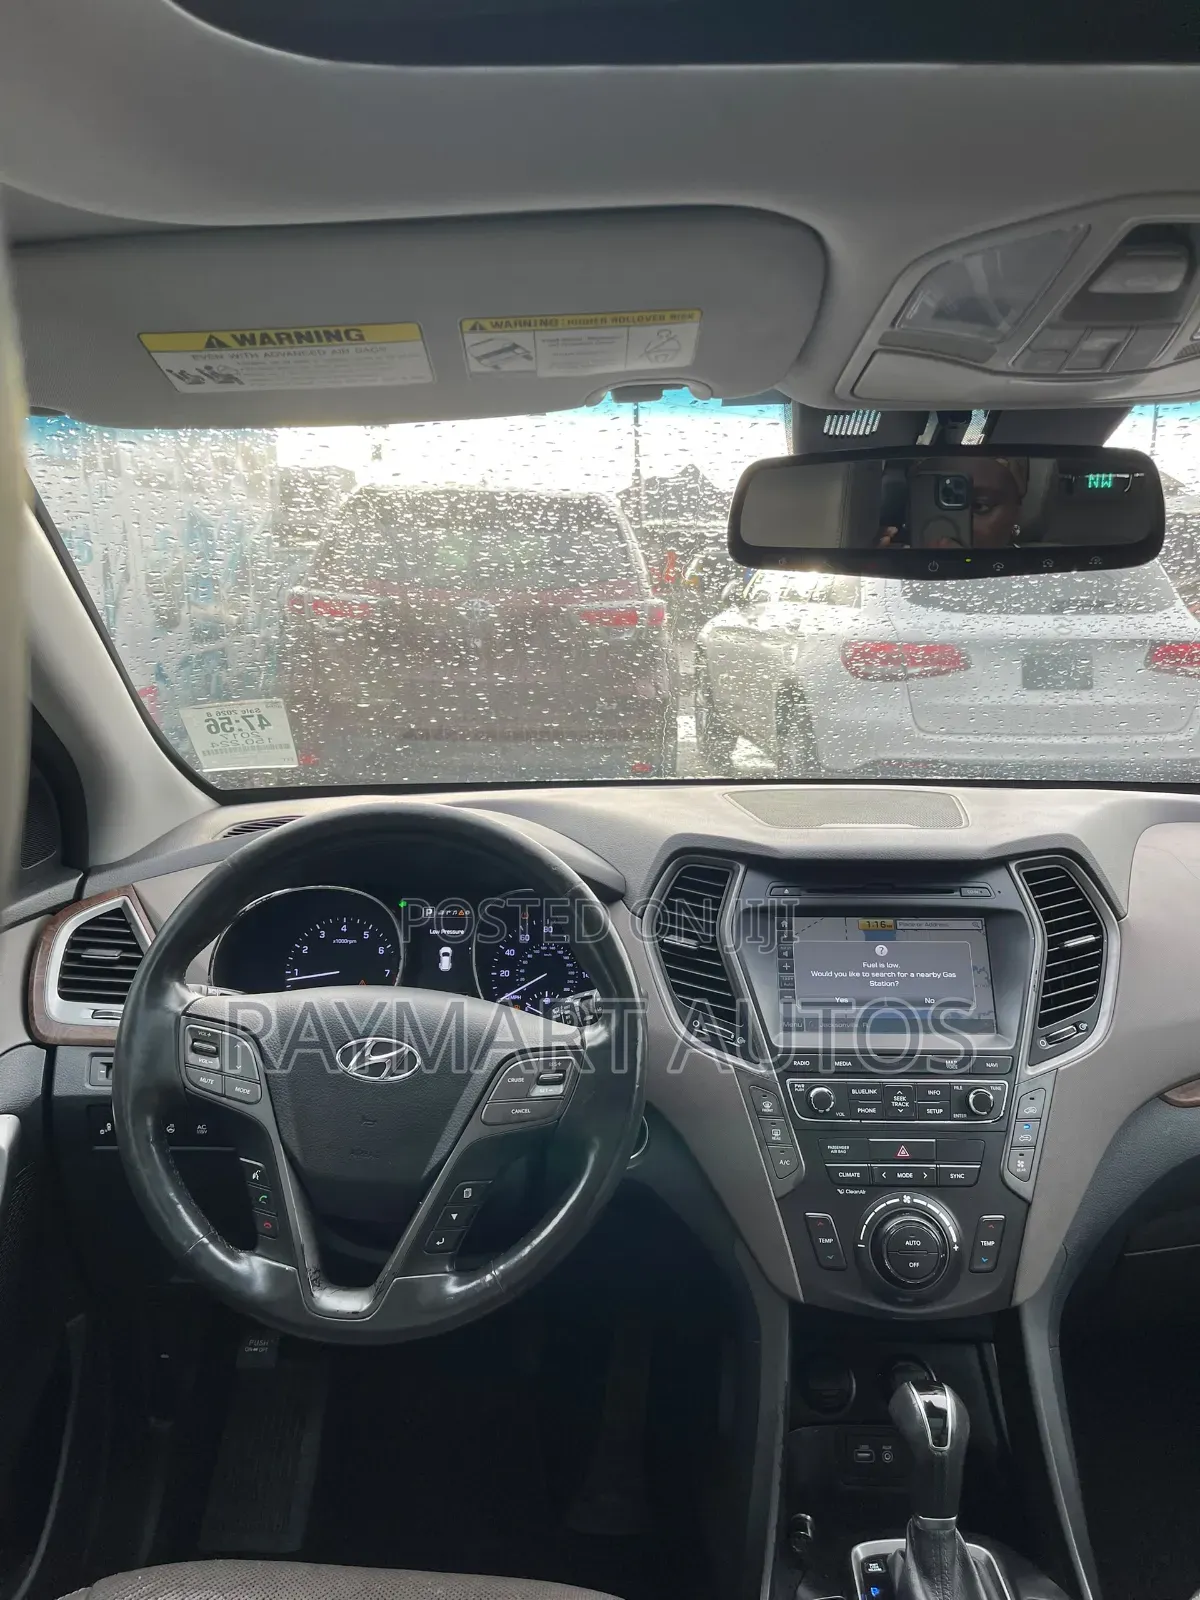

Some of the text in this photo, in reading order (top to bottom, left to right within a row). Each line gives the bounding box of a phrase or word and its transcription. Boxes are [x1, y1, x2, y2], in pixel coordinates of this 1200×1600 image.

[230, 328, 366, 347] WARNING
[1088, 473, 1112, 488] NW
[341, 924, 347, 932] 4
[319, 930, 326, 938] 3
[363, 931, 369, 939] 5
[520, 934, 530, 942] 60
[302, 945, 308, 954] 2
[378, 946, 384, 955] 6
[505, 948, 515, 957] 40
[294, 968, 299, 976] 1
[384, 969, 391, 977] 7
[834, 971, 847, 979] you
[916, 971, 941, 979] nearby
[200, 1076, 214, 1084] MUTE
[234, 1086, 251, 1095] MODE
